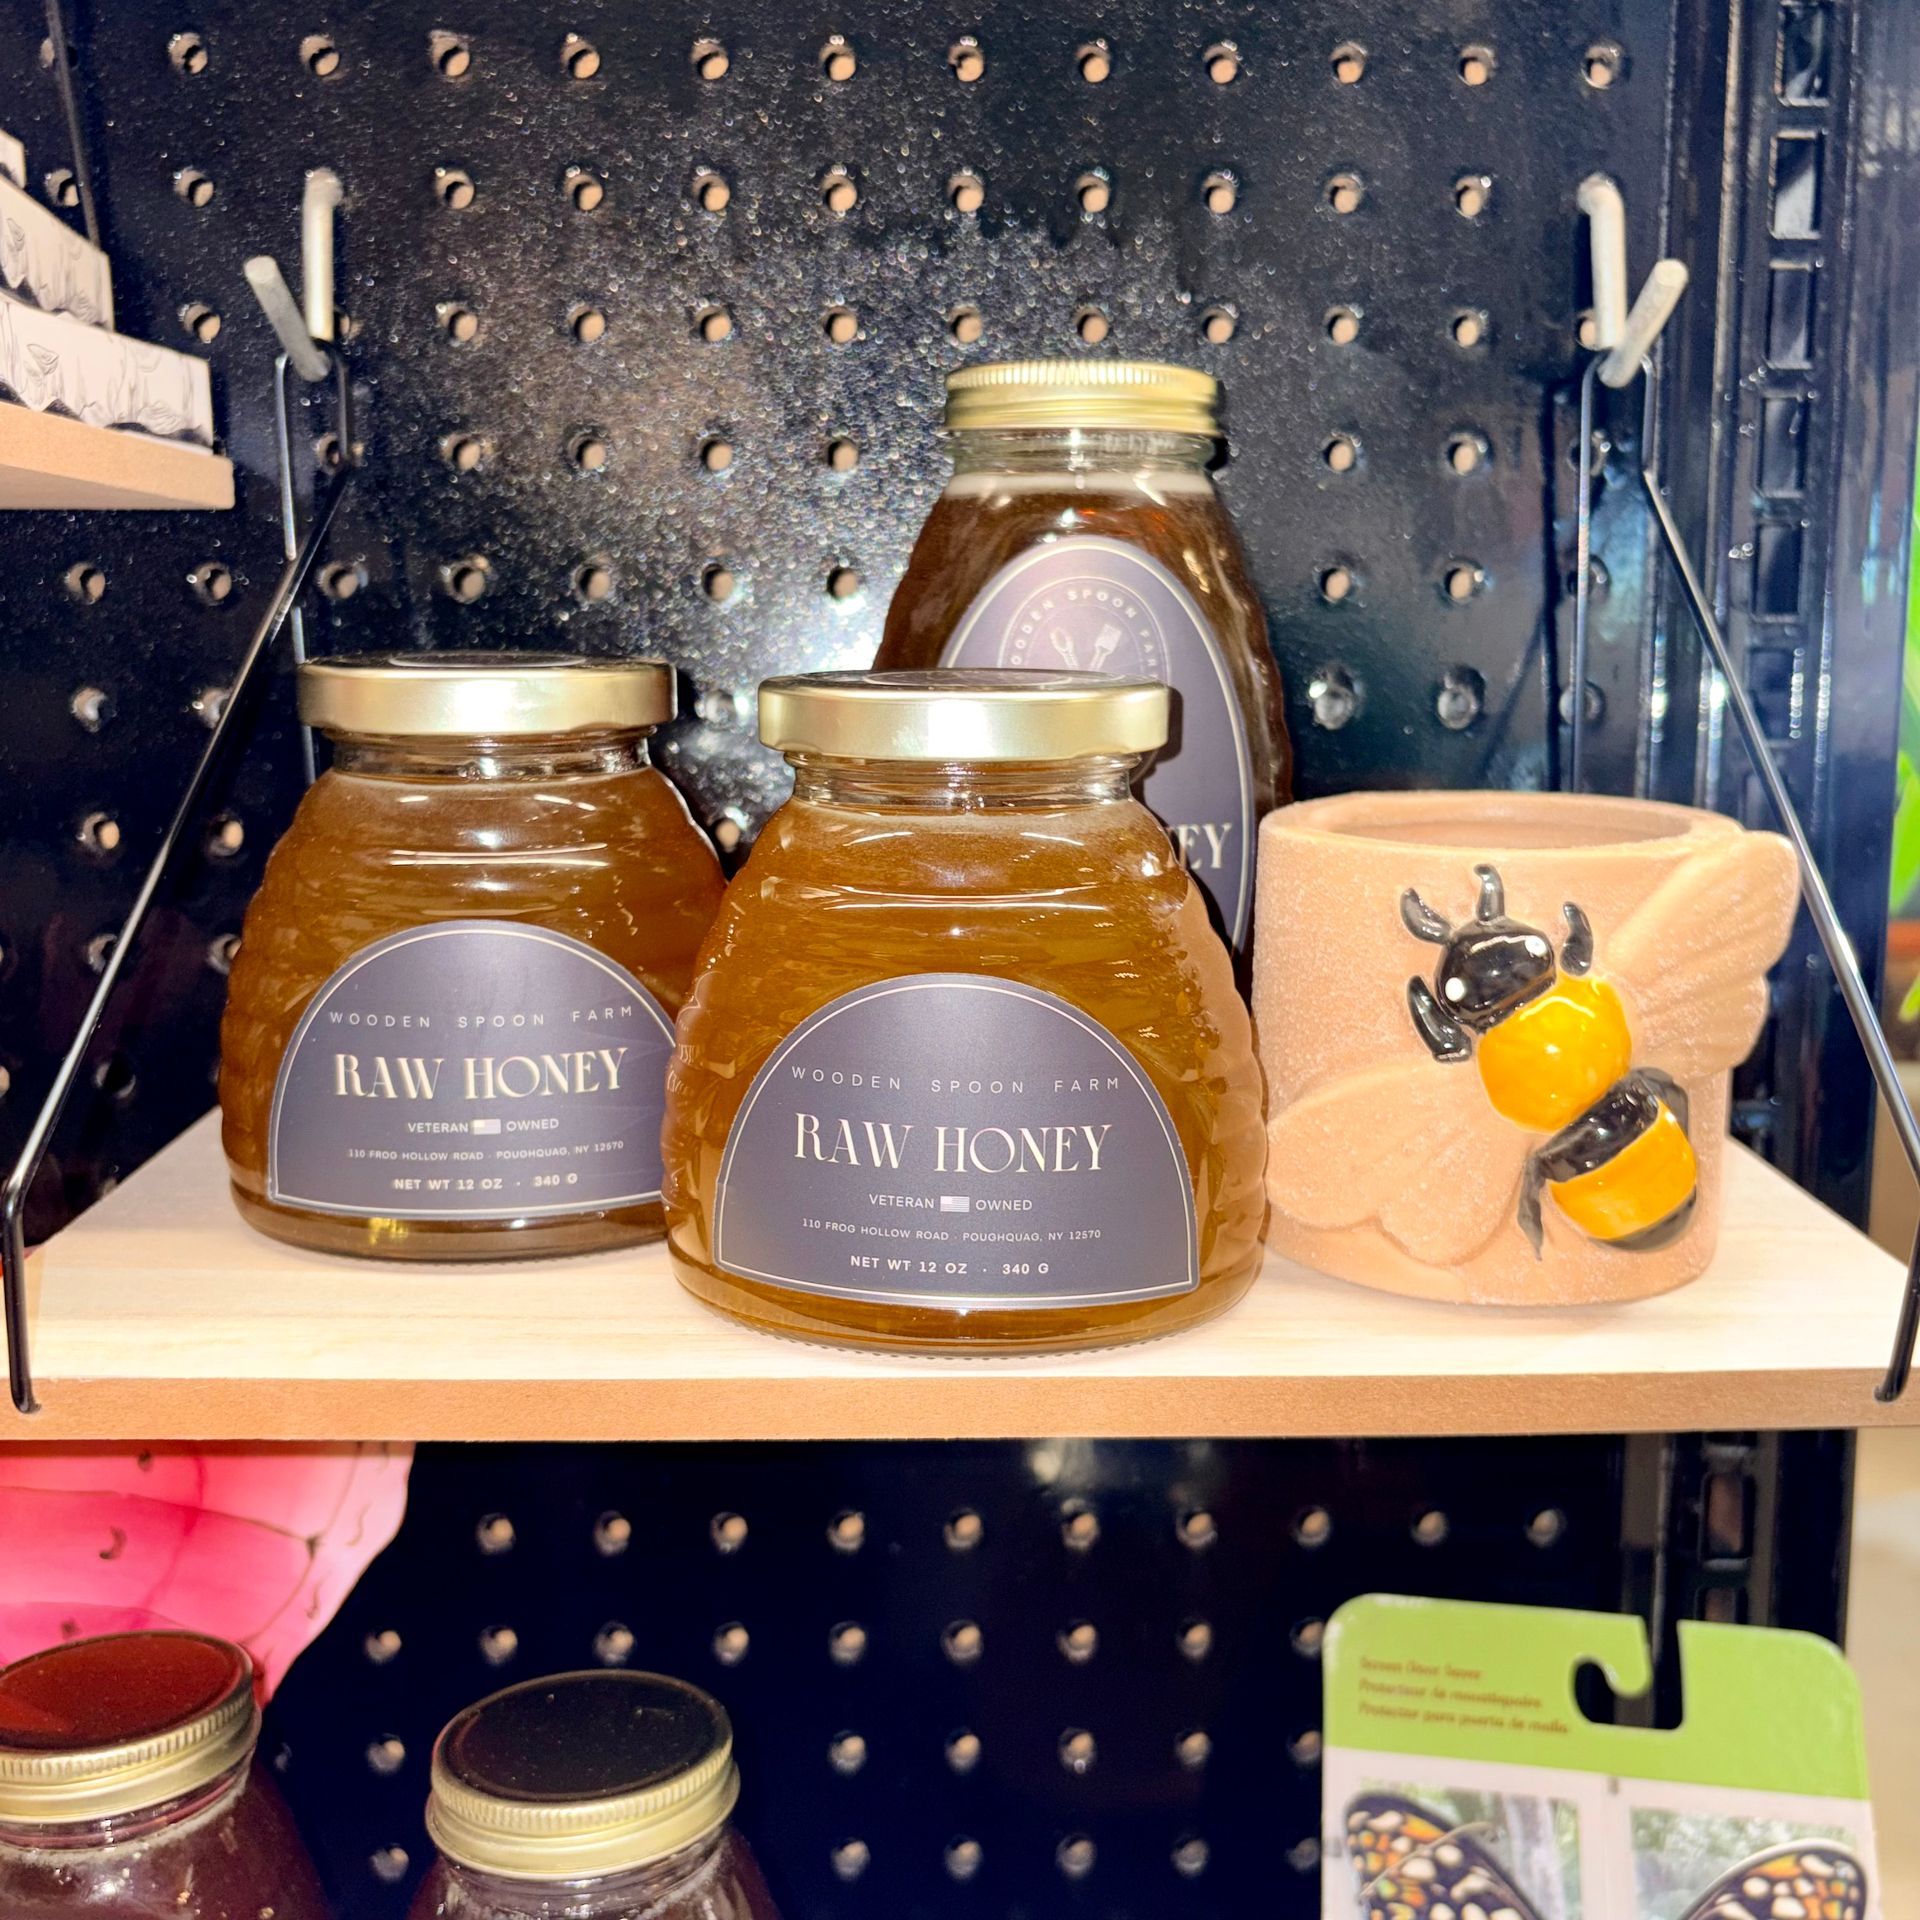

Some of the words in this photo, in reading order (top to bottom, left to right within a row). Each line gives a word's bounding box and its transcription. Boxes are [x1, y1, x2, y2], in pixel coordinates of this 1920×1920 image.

[1010, 600, 1055, 666] OODEN
[1066, 589, 1138, 619] SPOON
[330, 1012, 430, 1028] WOODEN
[458, 1014, 544, 1028] SPOON
[572, 1005, 632, 1022] FARM
[335, 1053, 445, 1099] RAW
[463, 1047, 628, 1099] HONEY
[791, 1066, 900, 1090] WOODEN
[931, 1080, 1023, 1094] SPOON
[1054, 1077, 1119, 1093] FARM
[407, 1122, 469, 1134] VETERAN
[506, 1118, 559, 1131] OWNED
[349, 1149, 366, 1158] 110
[402, 1153, 448, 1161] HOLLOW
[453, 1151, 484, 1161] ROAD
[575, 1146, 589, 1155] NY
[794, 1113, 914, 1169] RAW
[934, 1124, 1112, 1173] HONEY
[394, 1179, 421, 1190] NET
[428, 1179, 450, 1190] WT
[458, 1179, 474, 1190] 12
[482, 1178, 503, 1189] OZ
[534, 1175, 560, 1187] 340
[567, 1172, 578, 1185] G
[869, 1193, 935, 1209] VETERAN
[975, 1199, 1033, 1212] OWNED
[802, 1218, 821, 1229] 110
[825, 1220, 856, 1234] FROG
[860, 1226, 911, 1239] HOLLOW
[916, 1230, 949, 1241] ROAD
[963, 1231, 1043, 1243] POUGHQUAG,
[1048, 1231, 1064, 1241] NY
[1068, 1229, 1101, 1240] 12570
[850, 1255, 880, 1269] NET
[886, 1259, 912, 1272] WT
[919, 1261, 937, 1273] 12
[945, 1262, 968, 1275] OZ
[1002, 1263, 1030, 1275] 340
[1038, 1263, 1050, 1275] G
